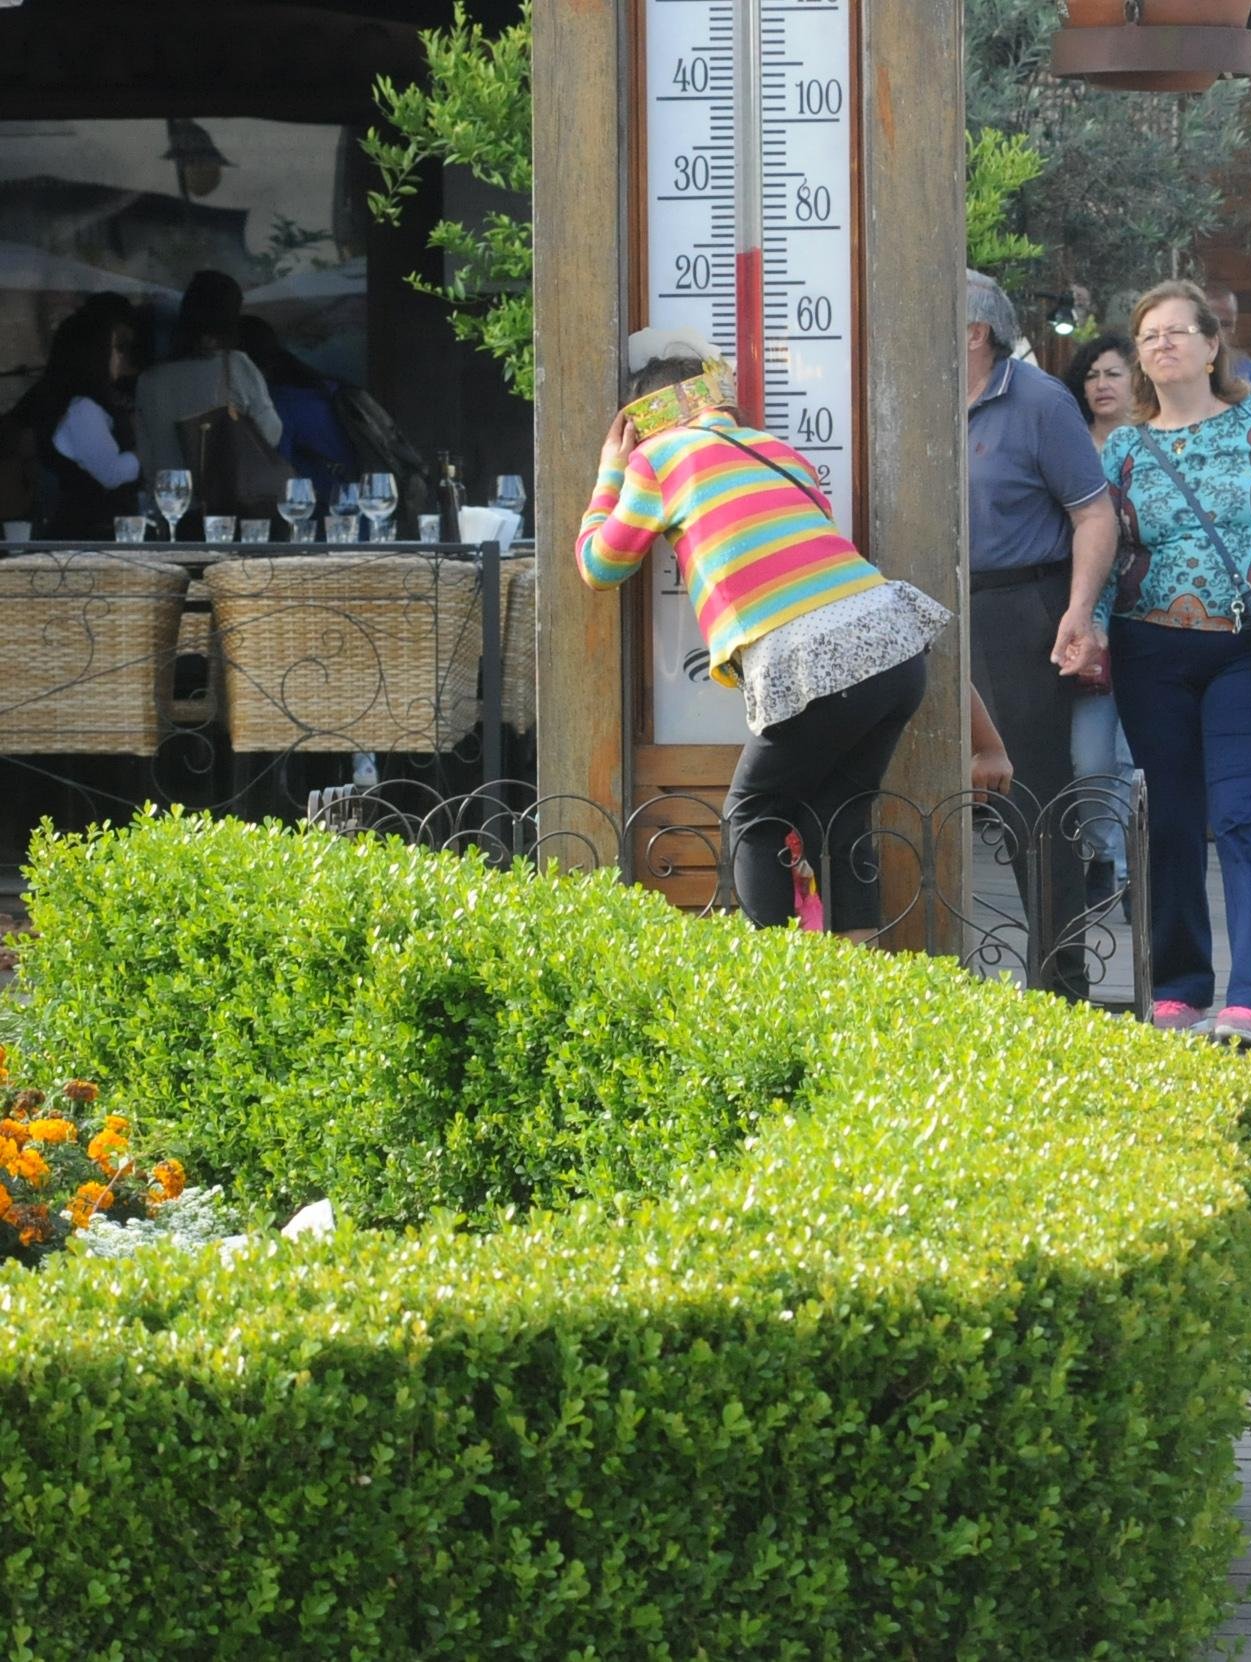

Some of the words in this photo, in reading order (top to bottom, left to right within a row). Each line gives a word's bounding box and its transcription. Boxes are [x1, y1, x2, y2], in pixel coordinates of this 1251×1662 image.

[672, 57, 709, 93] 40
[795, 78, 843, 115] 100
[673, 155, 710, 191] 30
[795, 178, 831, 222] 80
[675, 254, 711, 290] 20
[797, 296, 832, 331] 60
[797, 407, 833, 443] 40
